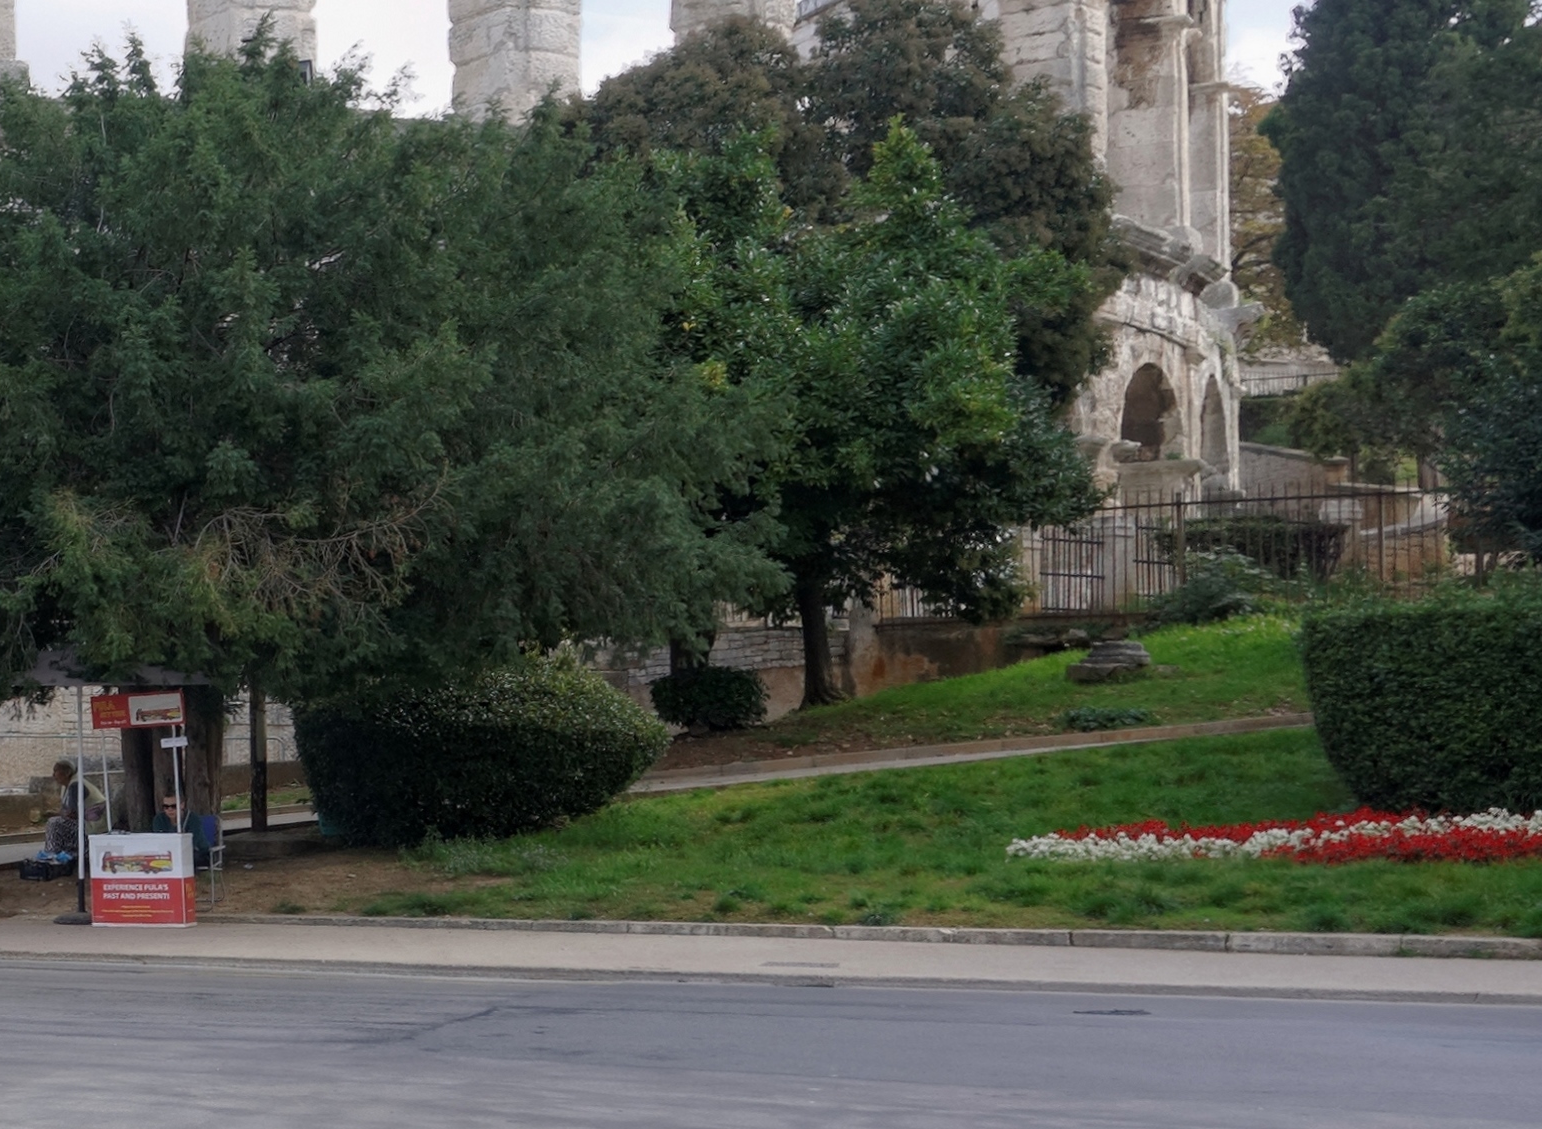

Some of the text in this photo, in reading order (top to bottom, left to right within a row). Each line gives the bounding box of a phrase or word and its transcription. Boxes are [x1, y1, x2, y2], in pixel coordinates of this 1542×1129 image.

[103, 883, 169, 891] EXPERIENCE PULA'S
[103, 892, 120, 900] PAST
[120, 892, 136, 900] AND
